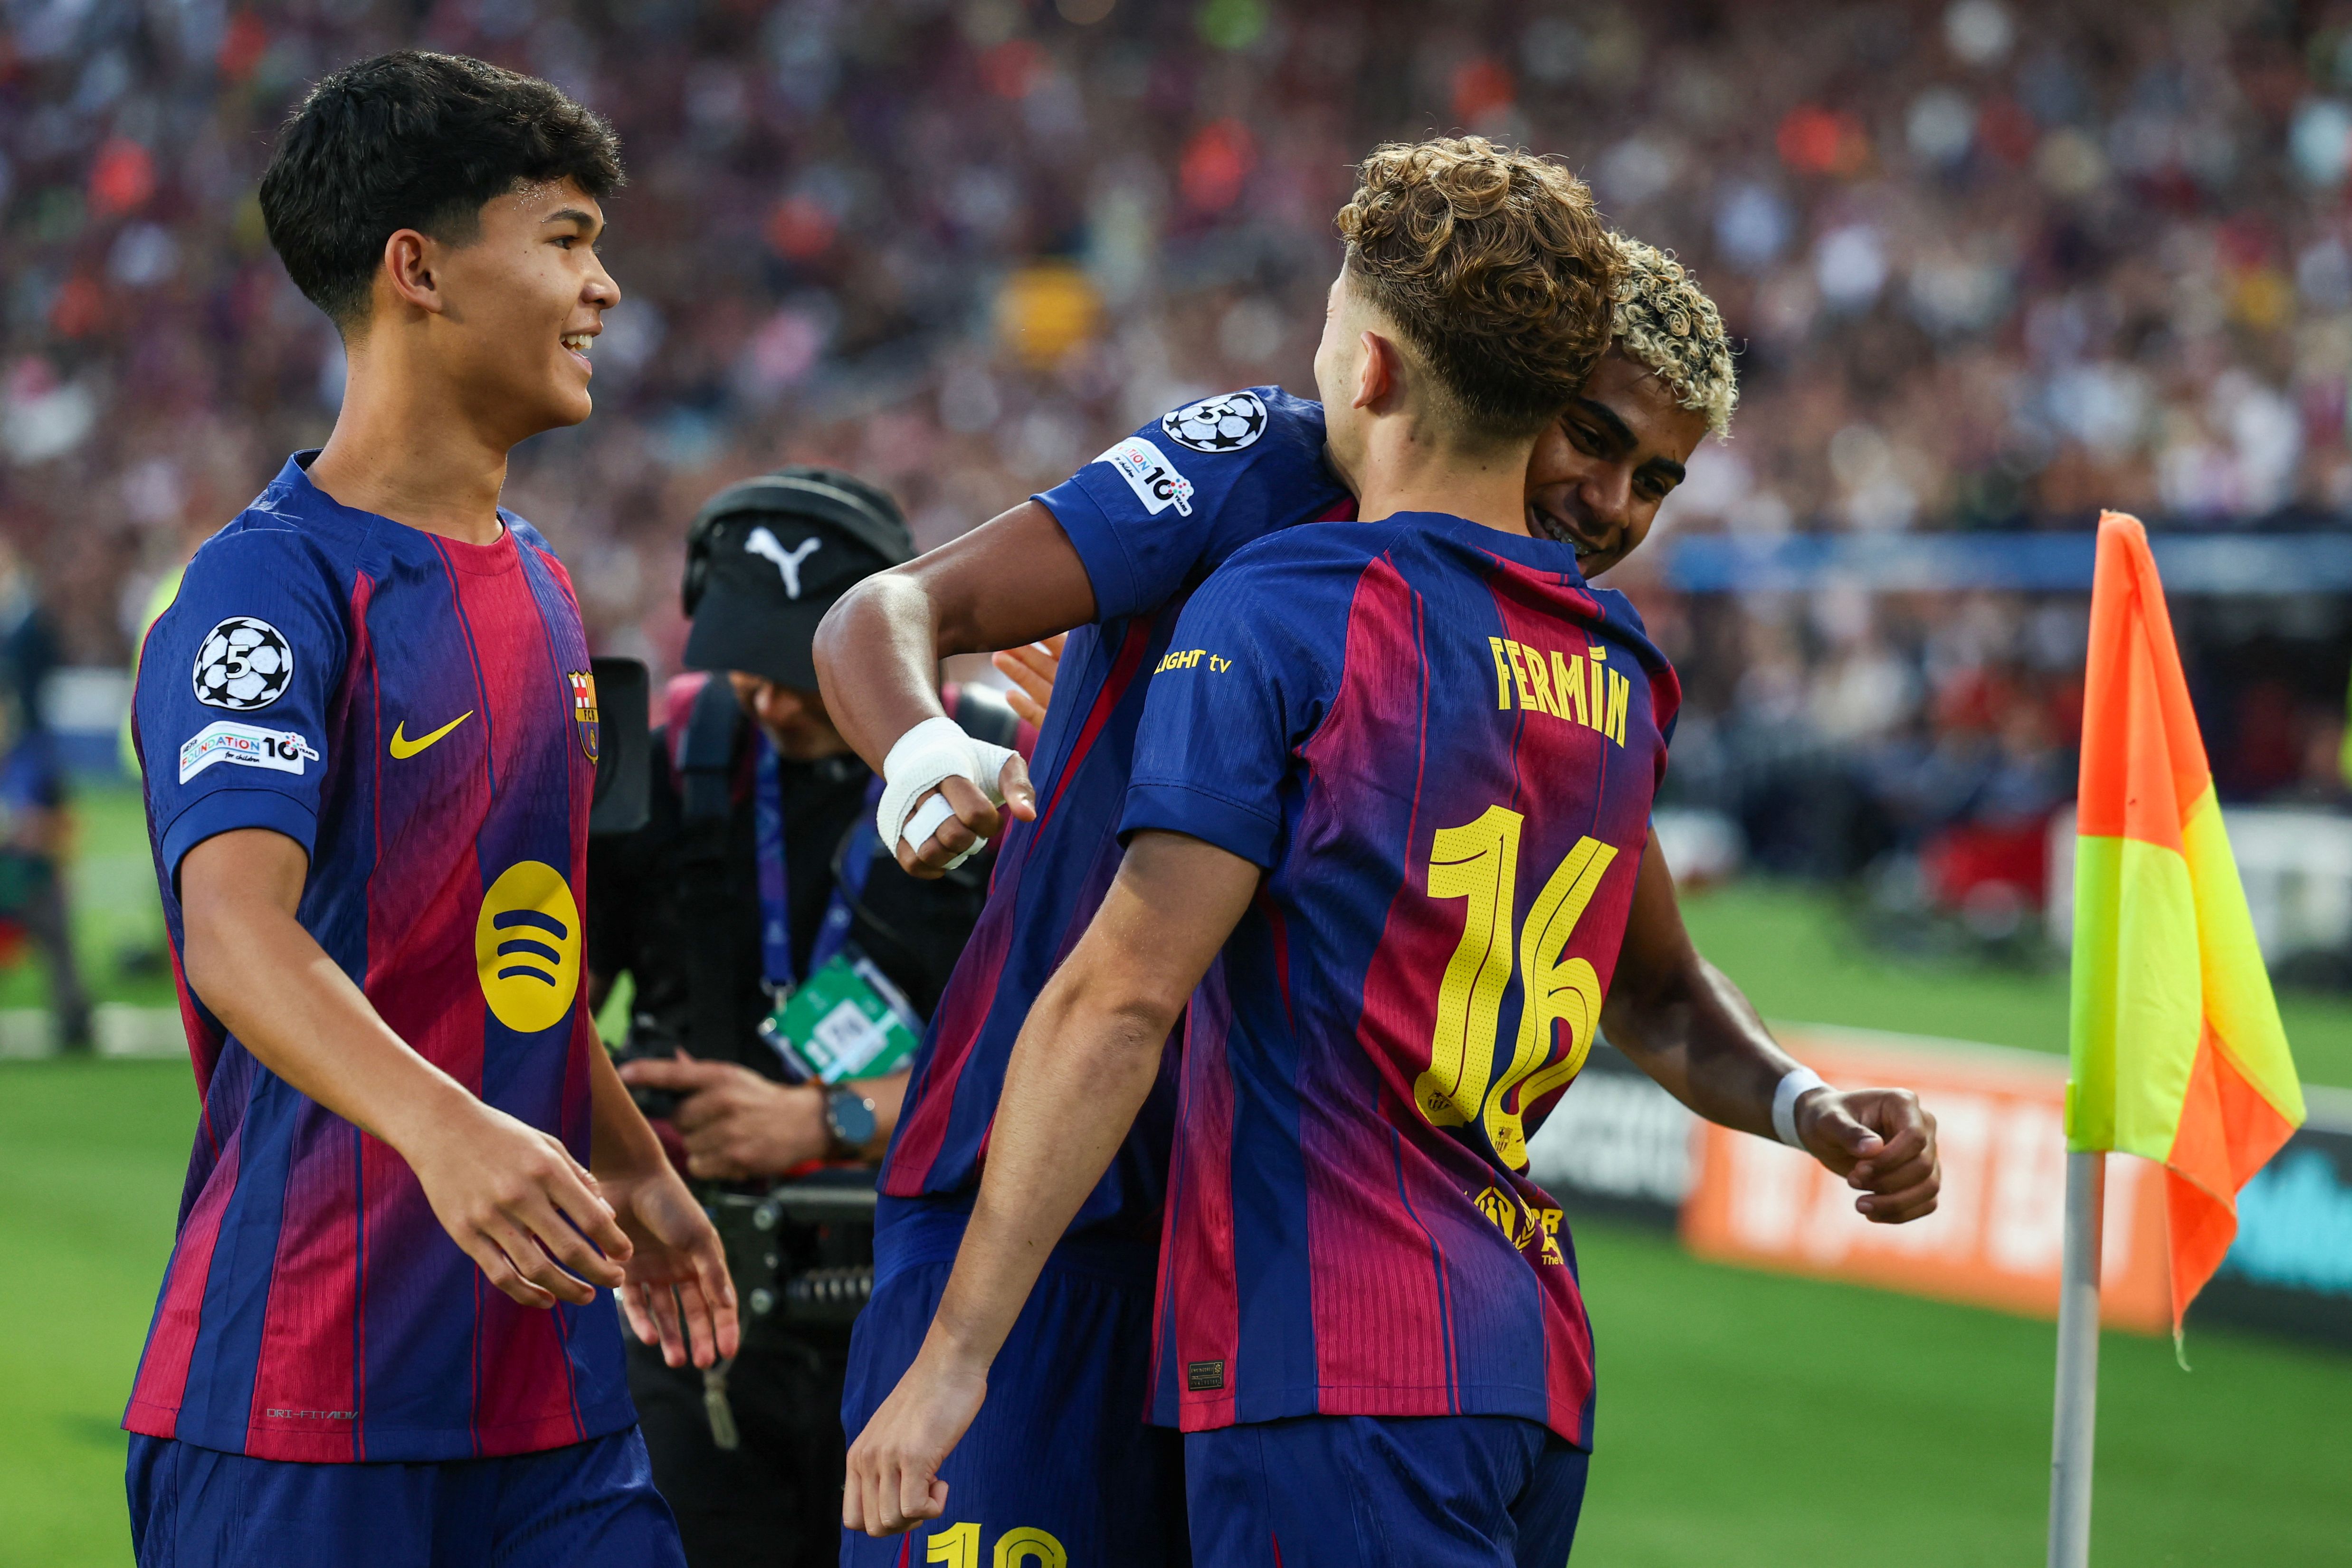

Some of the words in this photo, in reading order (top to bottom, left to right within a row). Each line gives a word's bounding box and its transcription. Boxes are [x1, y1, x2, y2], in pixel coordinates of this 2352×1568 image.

[1193, 403, 1235, 425] 5
[1144, 467, 1175, 500] 10
[1174, 494, 1188, 512] YEARS
[225, 645, 251, 679] 5
[1209, 654, 1232, 674] tv
[1488, 636, 1630, 748] FERMÍN
[235, 753, 260, 763] children
[263, 737, 299, 760] 10
[299, 748, 315, 757] YEARS
[1413, 804, 1619, 1171] 16
